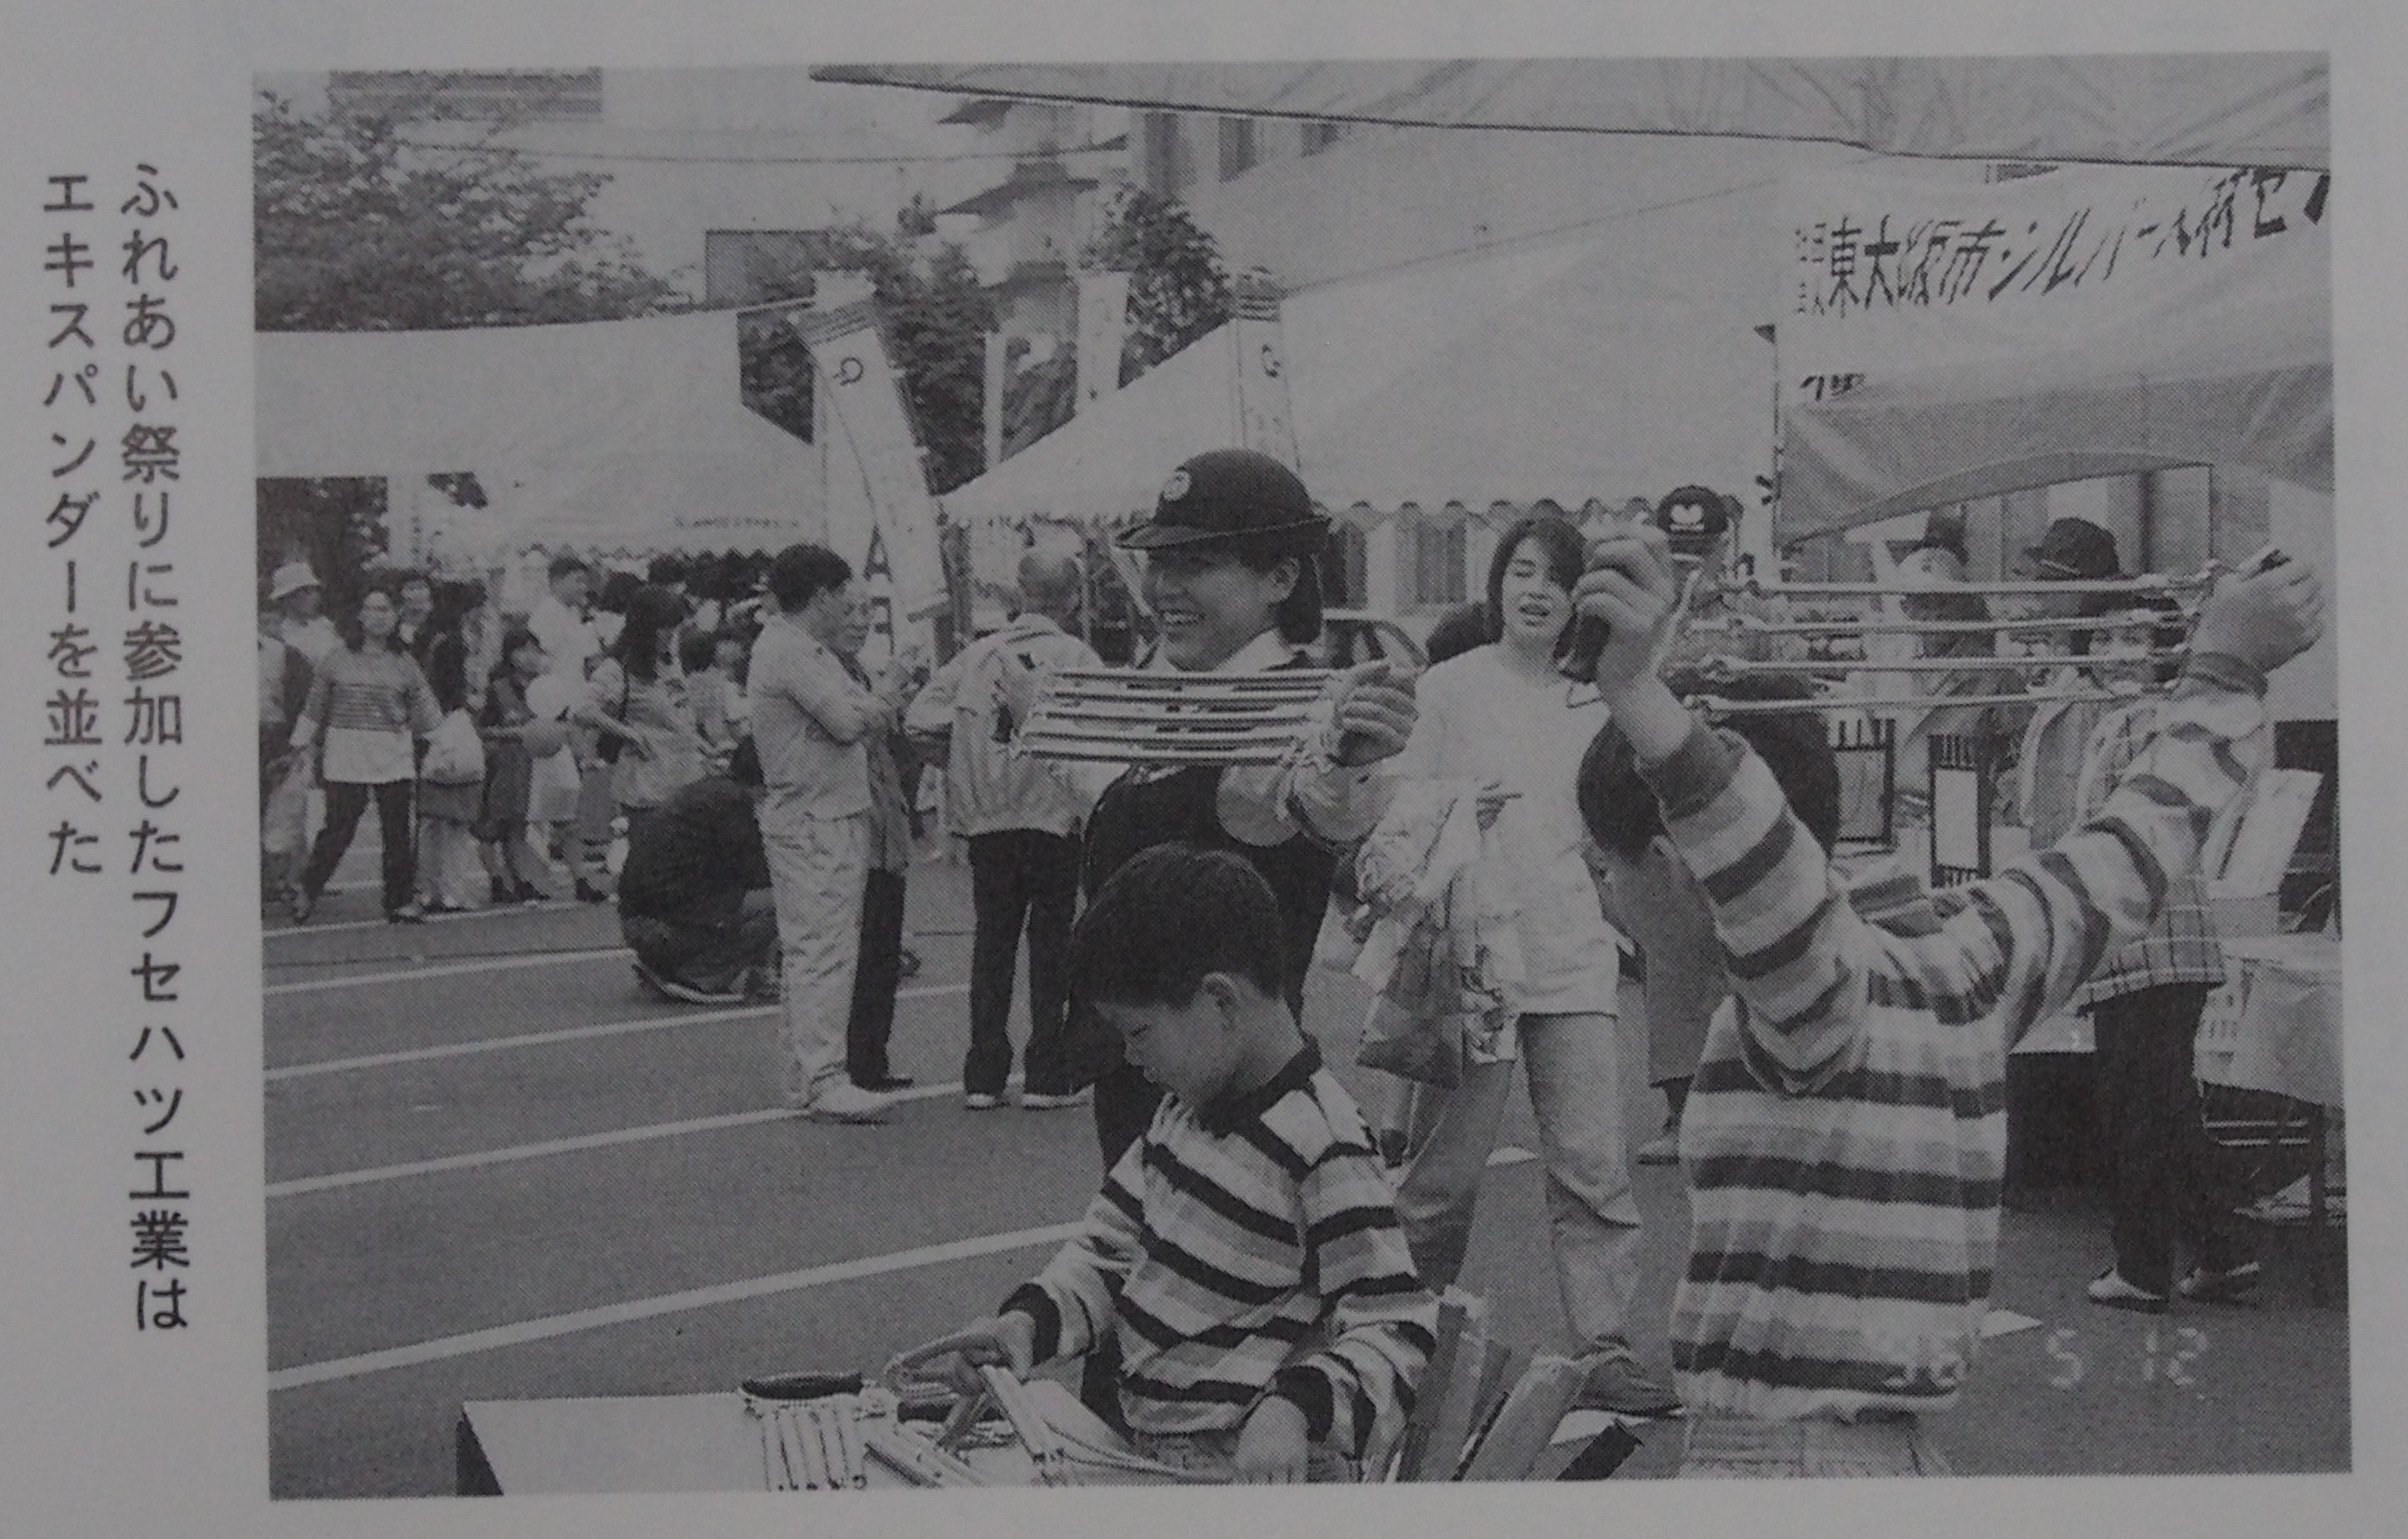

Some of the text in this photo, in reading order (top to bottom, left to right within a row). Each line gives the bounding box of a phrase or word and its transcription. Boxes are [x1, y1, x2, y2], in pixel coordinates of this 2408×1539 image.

[43, 175, 103, 876] エキスパンダーを並べた
[121, 163, 191, 1332] ふれあい祭りに参加したフセハツ工業は
